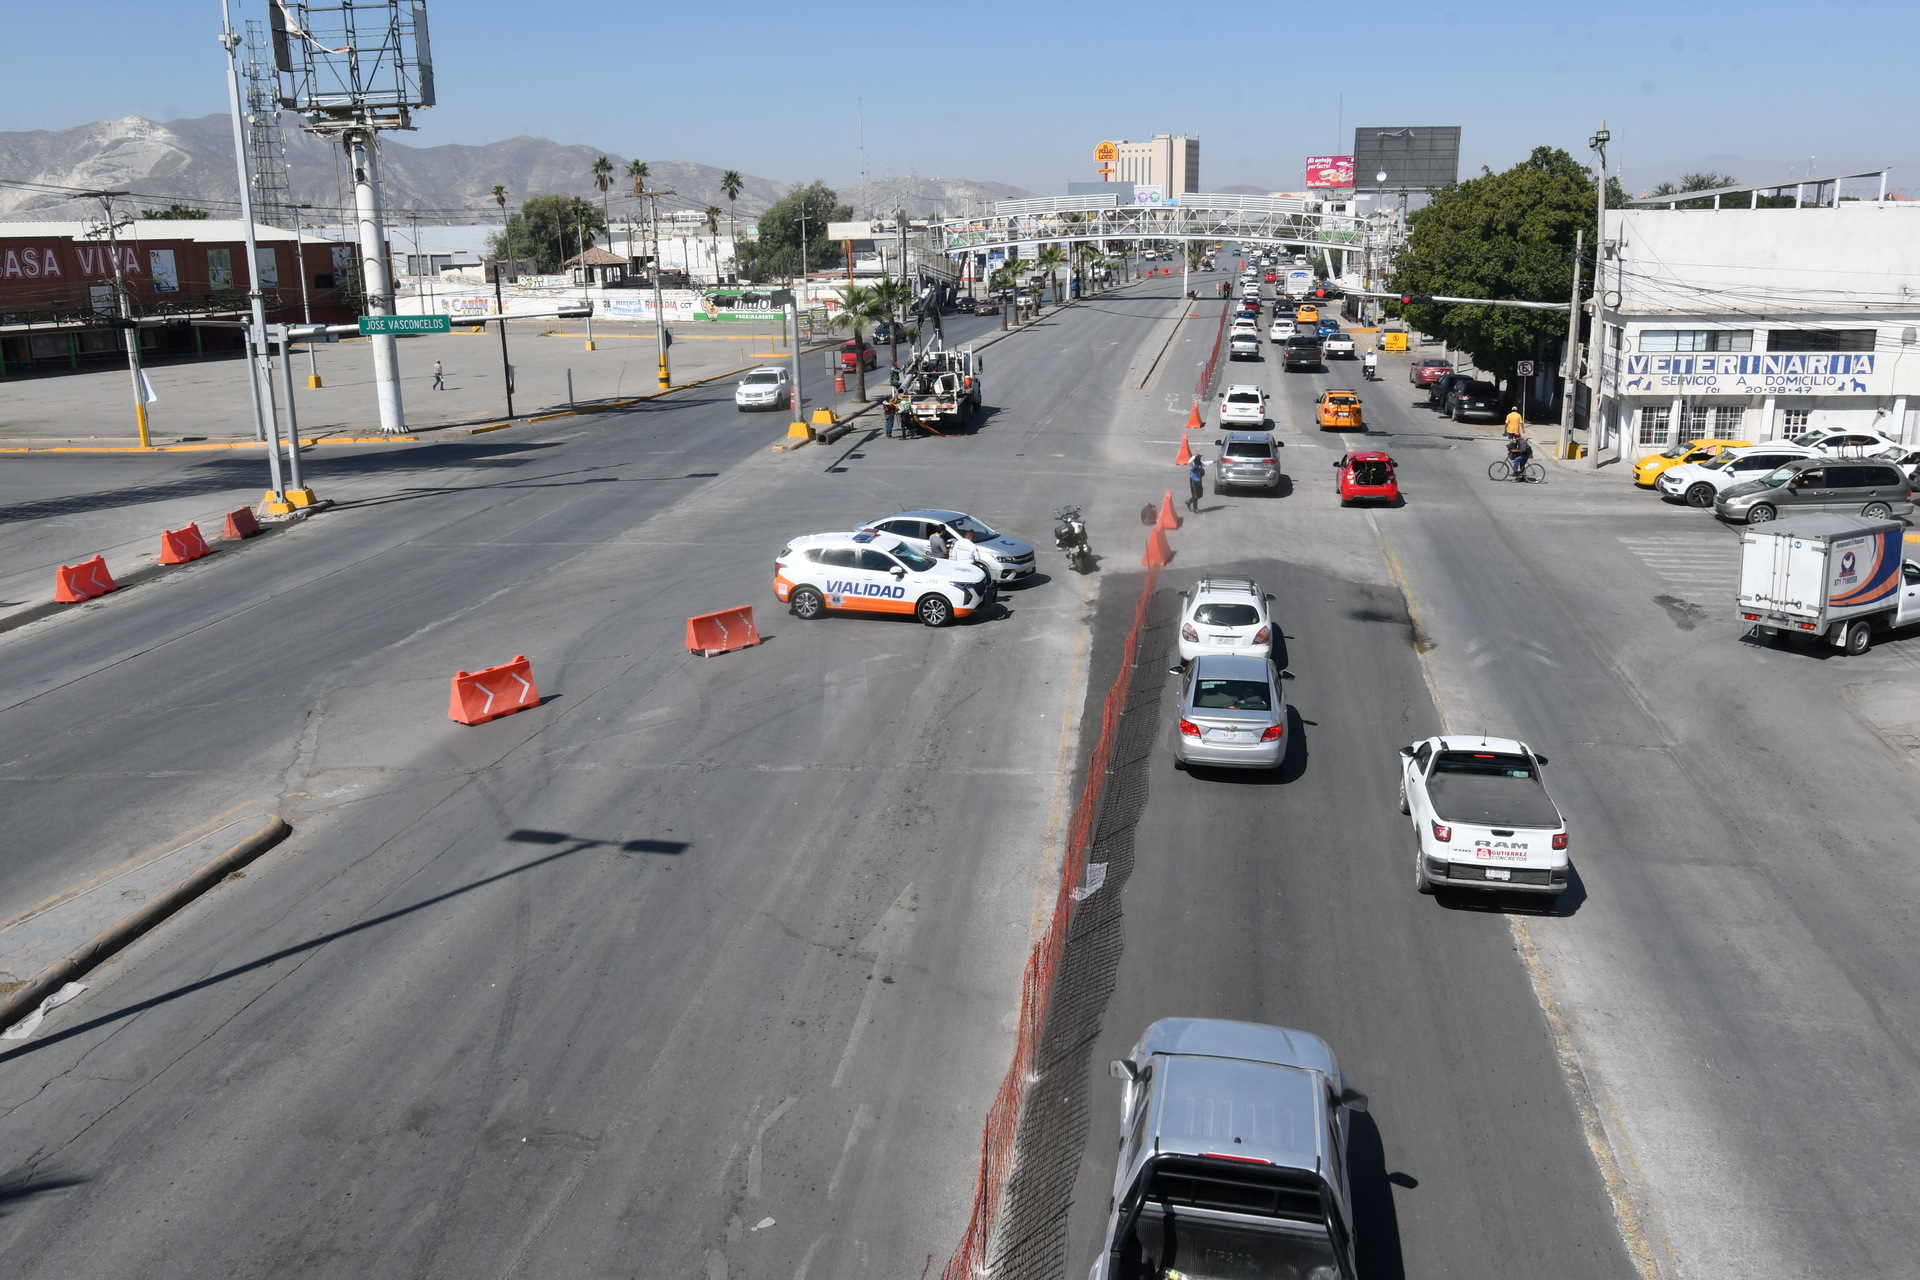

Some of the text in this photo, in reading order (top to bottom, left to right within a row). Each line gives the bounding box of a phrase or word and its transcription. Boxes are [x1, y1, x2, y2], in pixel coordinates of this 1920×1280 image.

[1315, 157, 1332, 165] antojo
[0, 246, 142, 279] ASA VIVA
[366, 319, 444, 330] JOSE VASCONCELOS
[1627, 354, 1875, 375] VETERINARIA
[1661, 376, 1837, 386] SERVICIO A DOMICILIO
[826, 580, 905, 599] VIALIDAD
[1474, 840, 1528, 849] RAM
